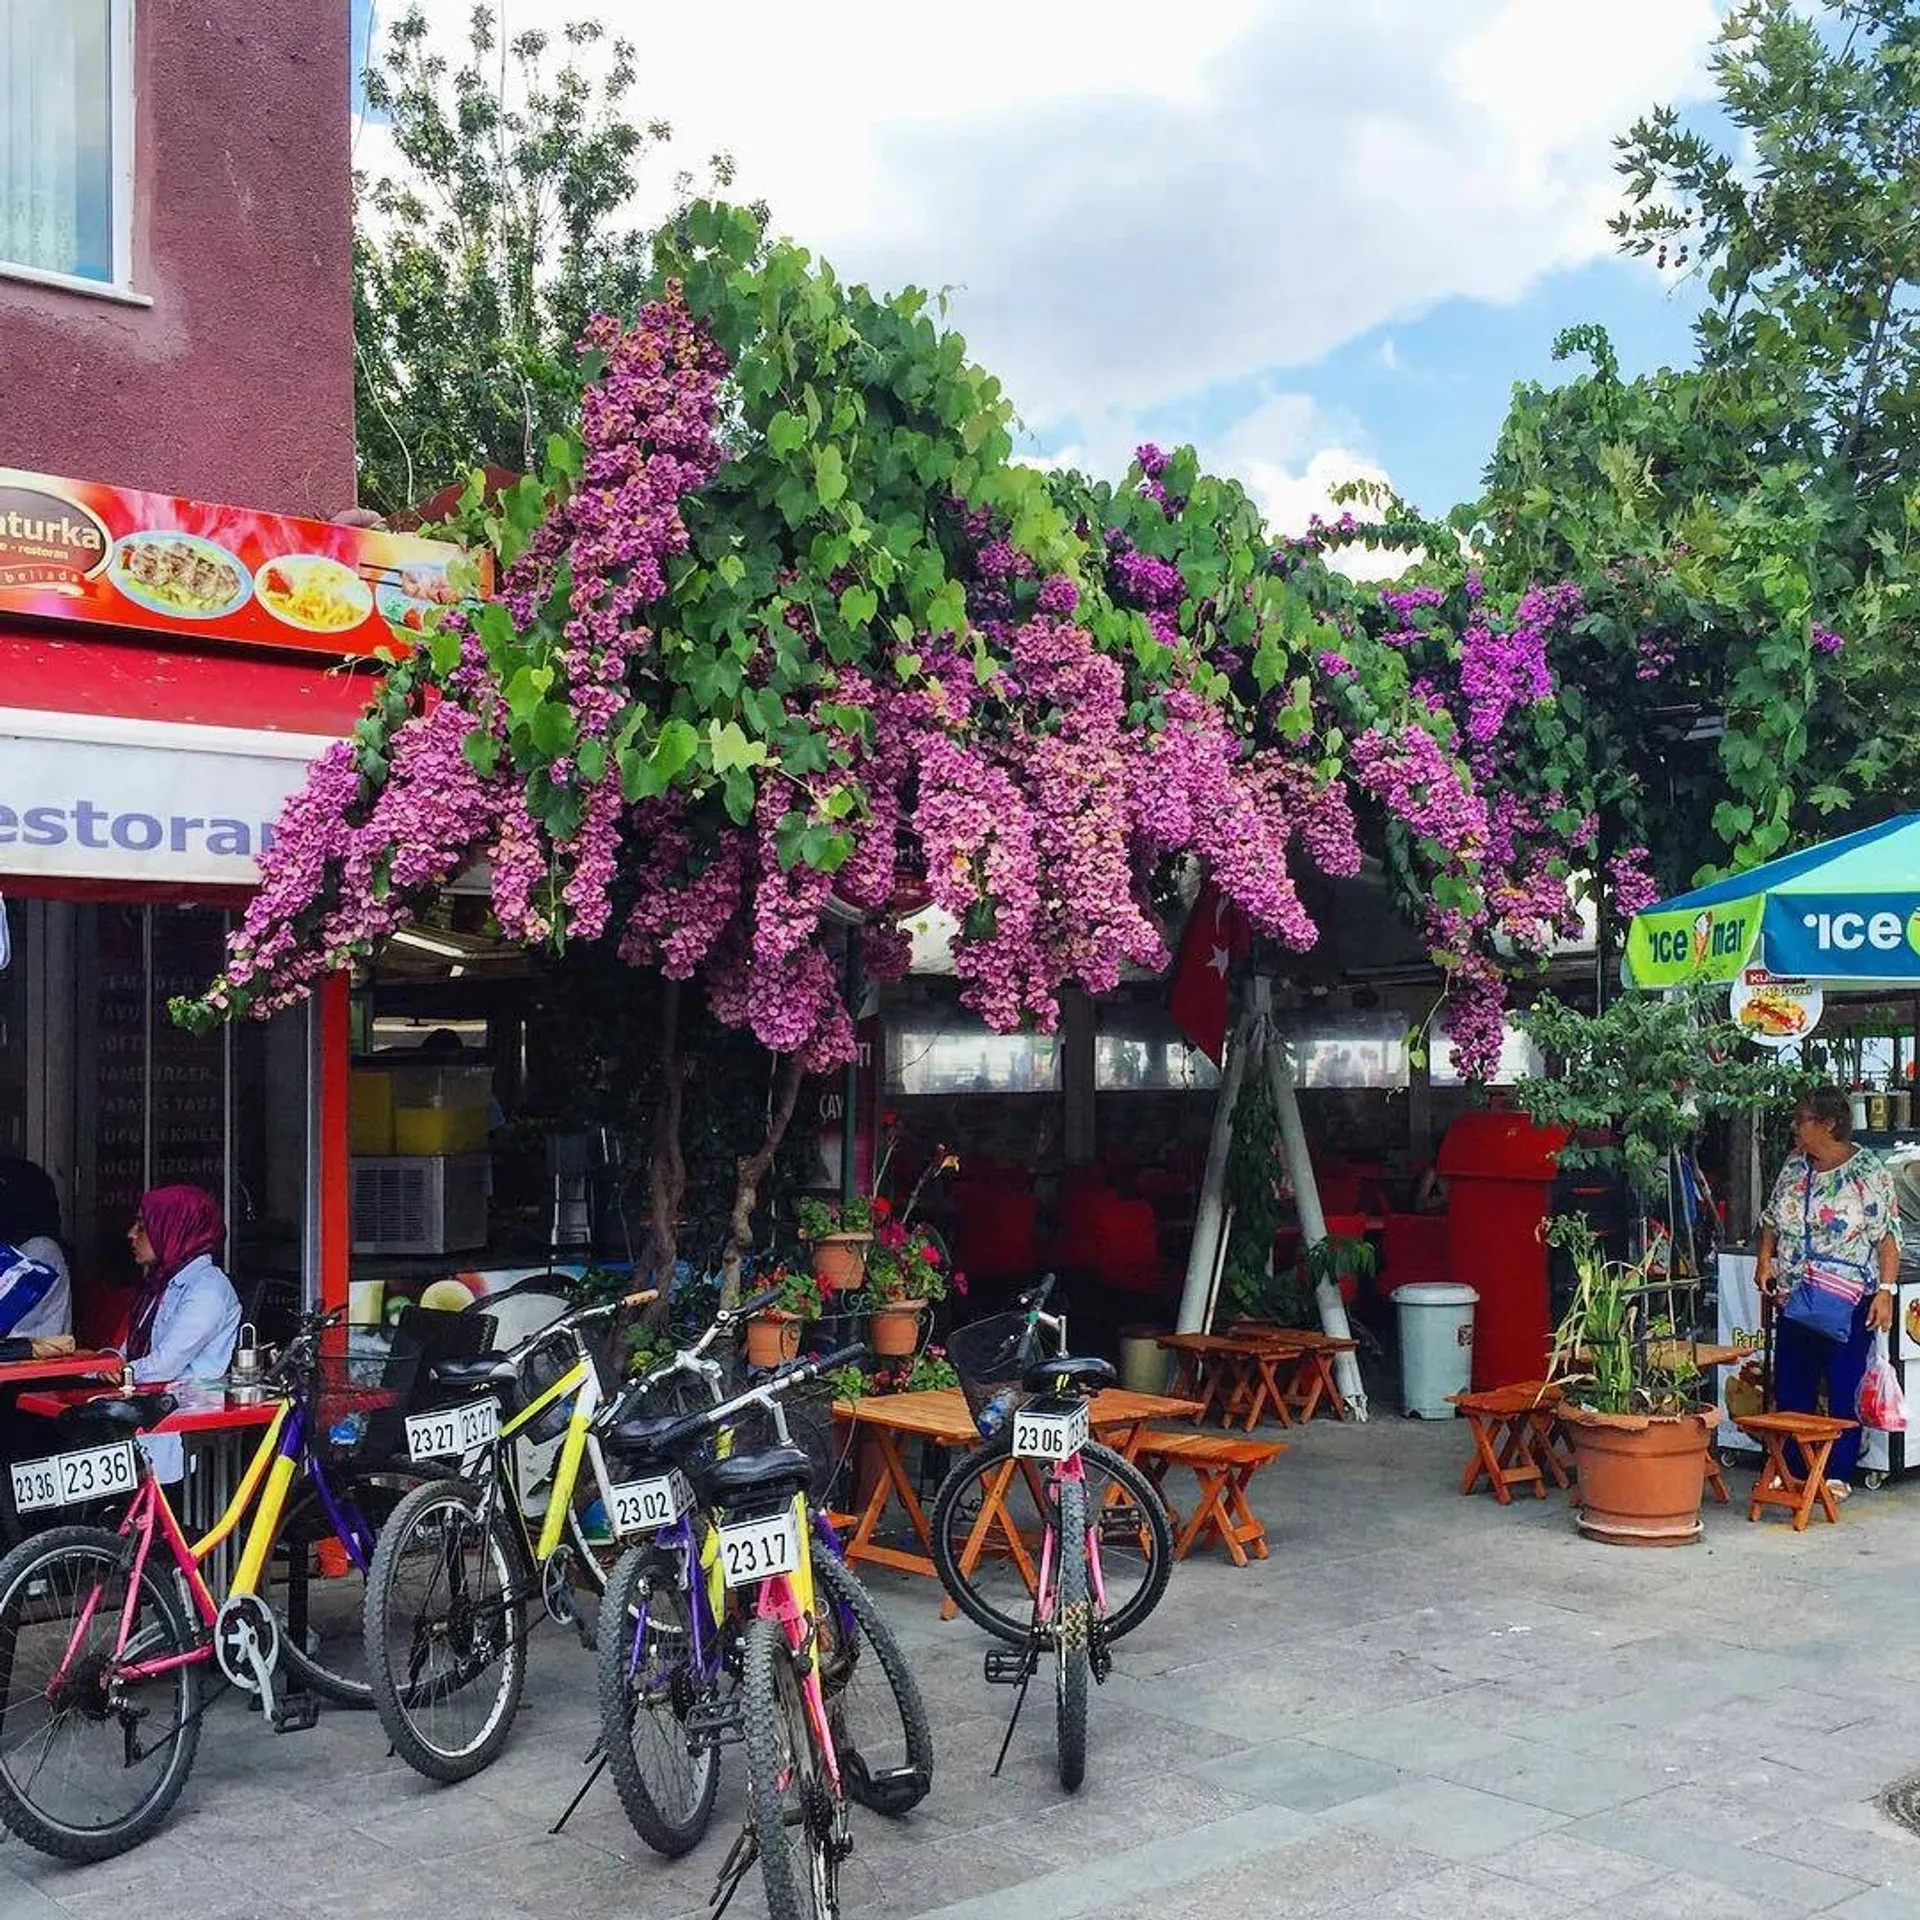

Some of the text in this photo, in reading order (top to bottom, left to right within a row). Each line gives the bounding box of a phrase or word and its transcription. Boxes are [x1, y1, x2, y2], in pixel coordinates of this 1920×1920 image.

[18, 545, 69, 560] restoran
[1712, 919, 1745, 957] mar
[1732, 1327, 1765, 1350] Fark
